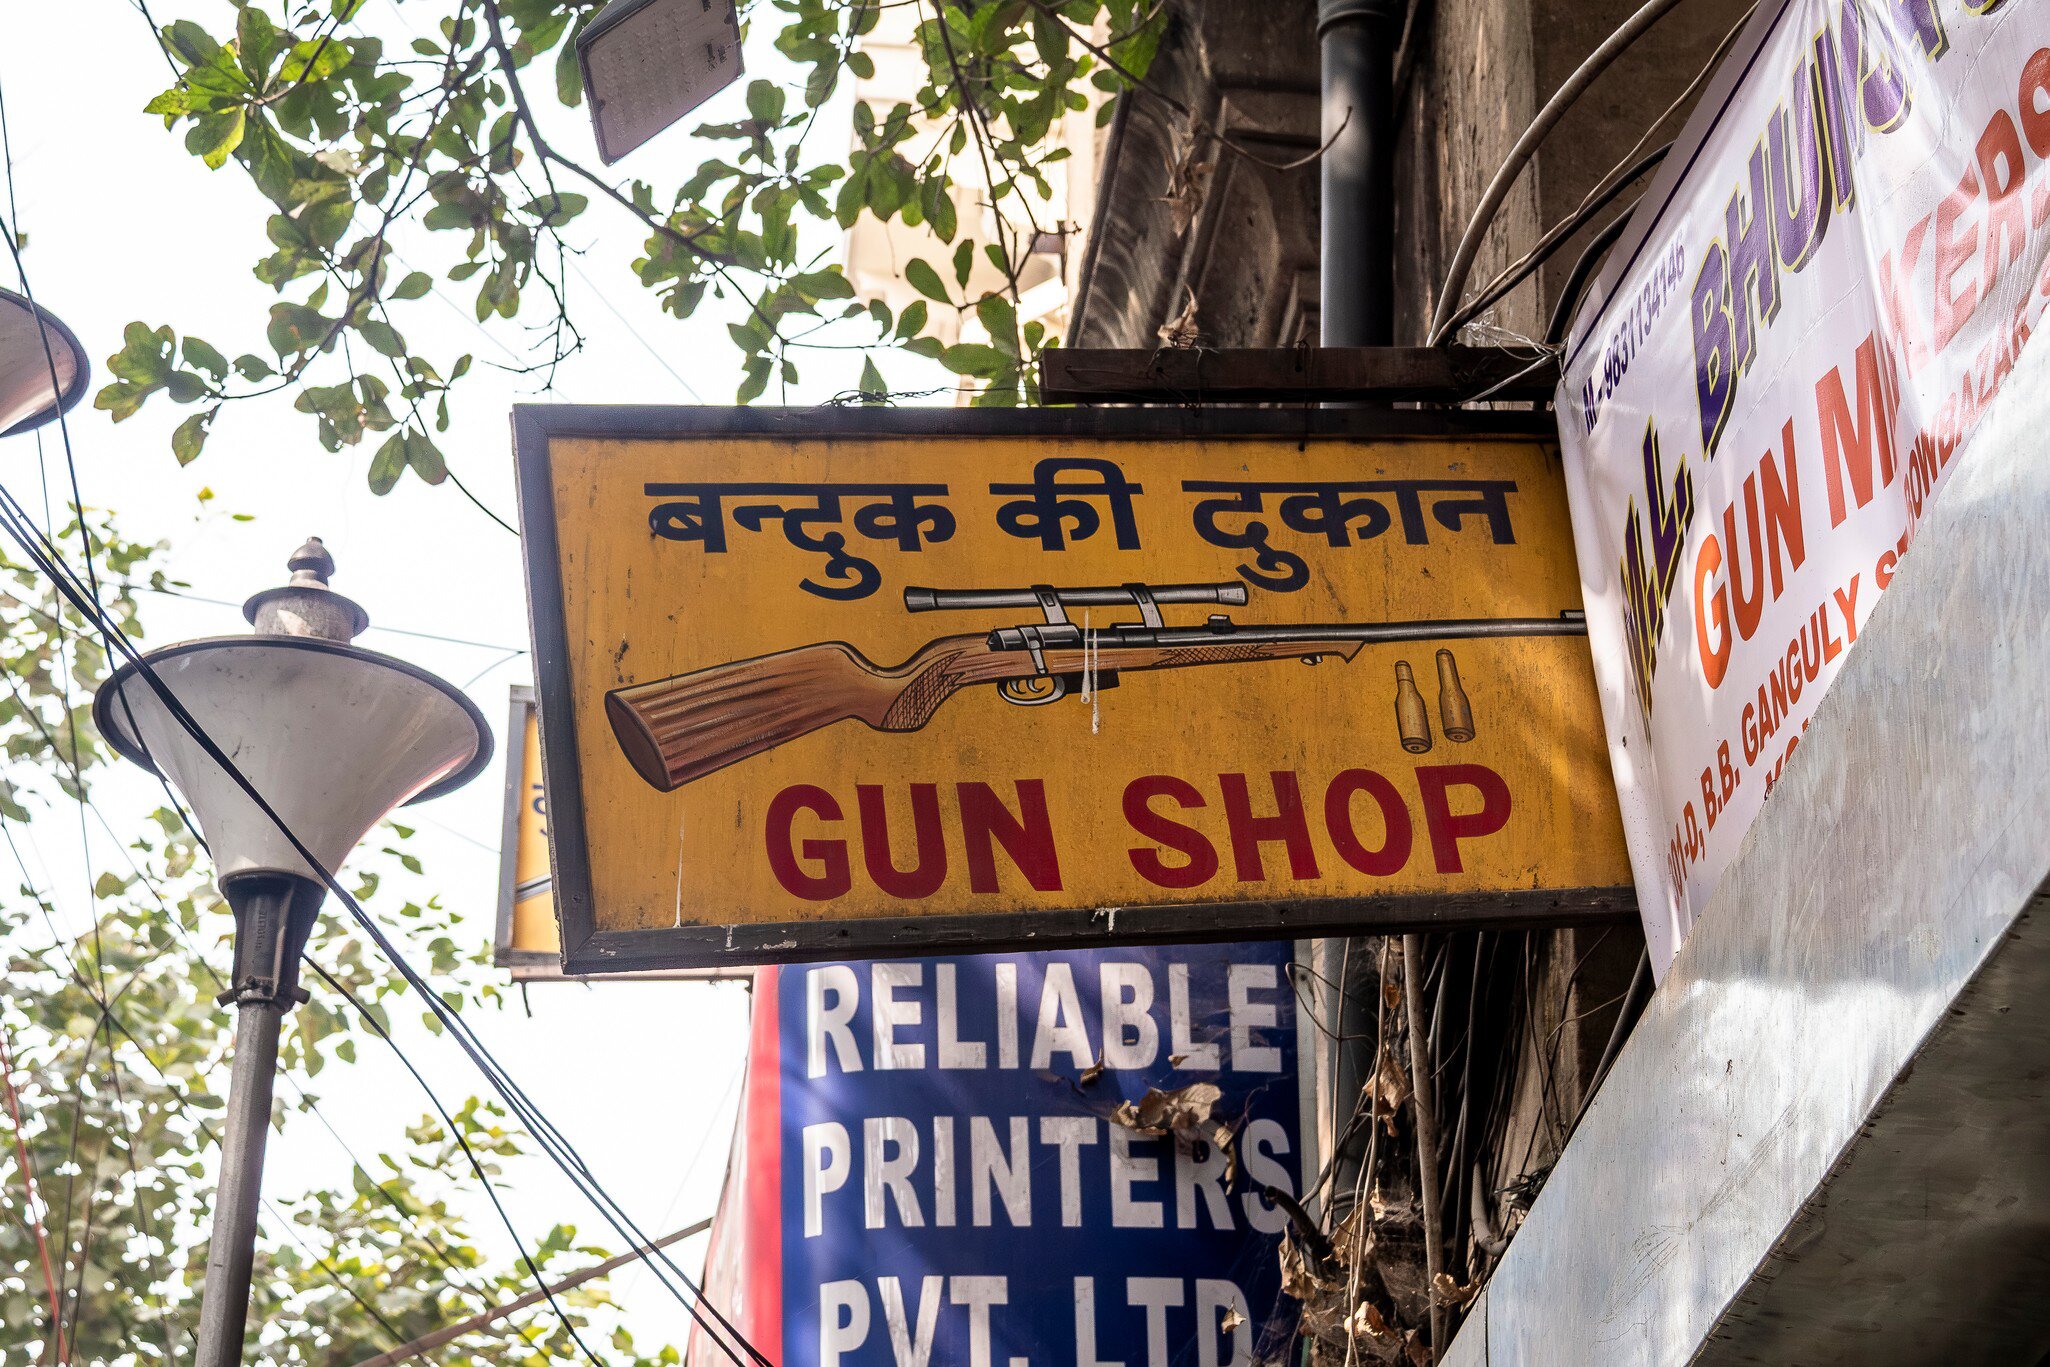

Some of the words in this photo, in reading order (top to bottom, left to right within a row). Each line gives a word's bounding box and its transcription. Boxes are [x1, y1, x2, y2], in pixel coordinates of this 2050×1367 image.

[989, 458, 1144, 553] की
[1181, 479, 1519, 593] दुकान
[1694, 415, 1806, 690] GUN
[1700, 739, 1741, 834] B.B.
[1741, 573, 1860, 768] GANGULY
[765, 778, 1064, 900] GUN
[1121, 763, 1513, 889] SHOP
[805, 961, 1283, 1081] RELIABLE
[802, 1115, 1295, 1239] PRINTERS
[818, 1275, 1030, 1367] PVT.
